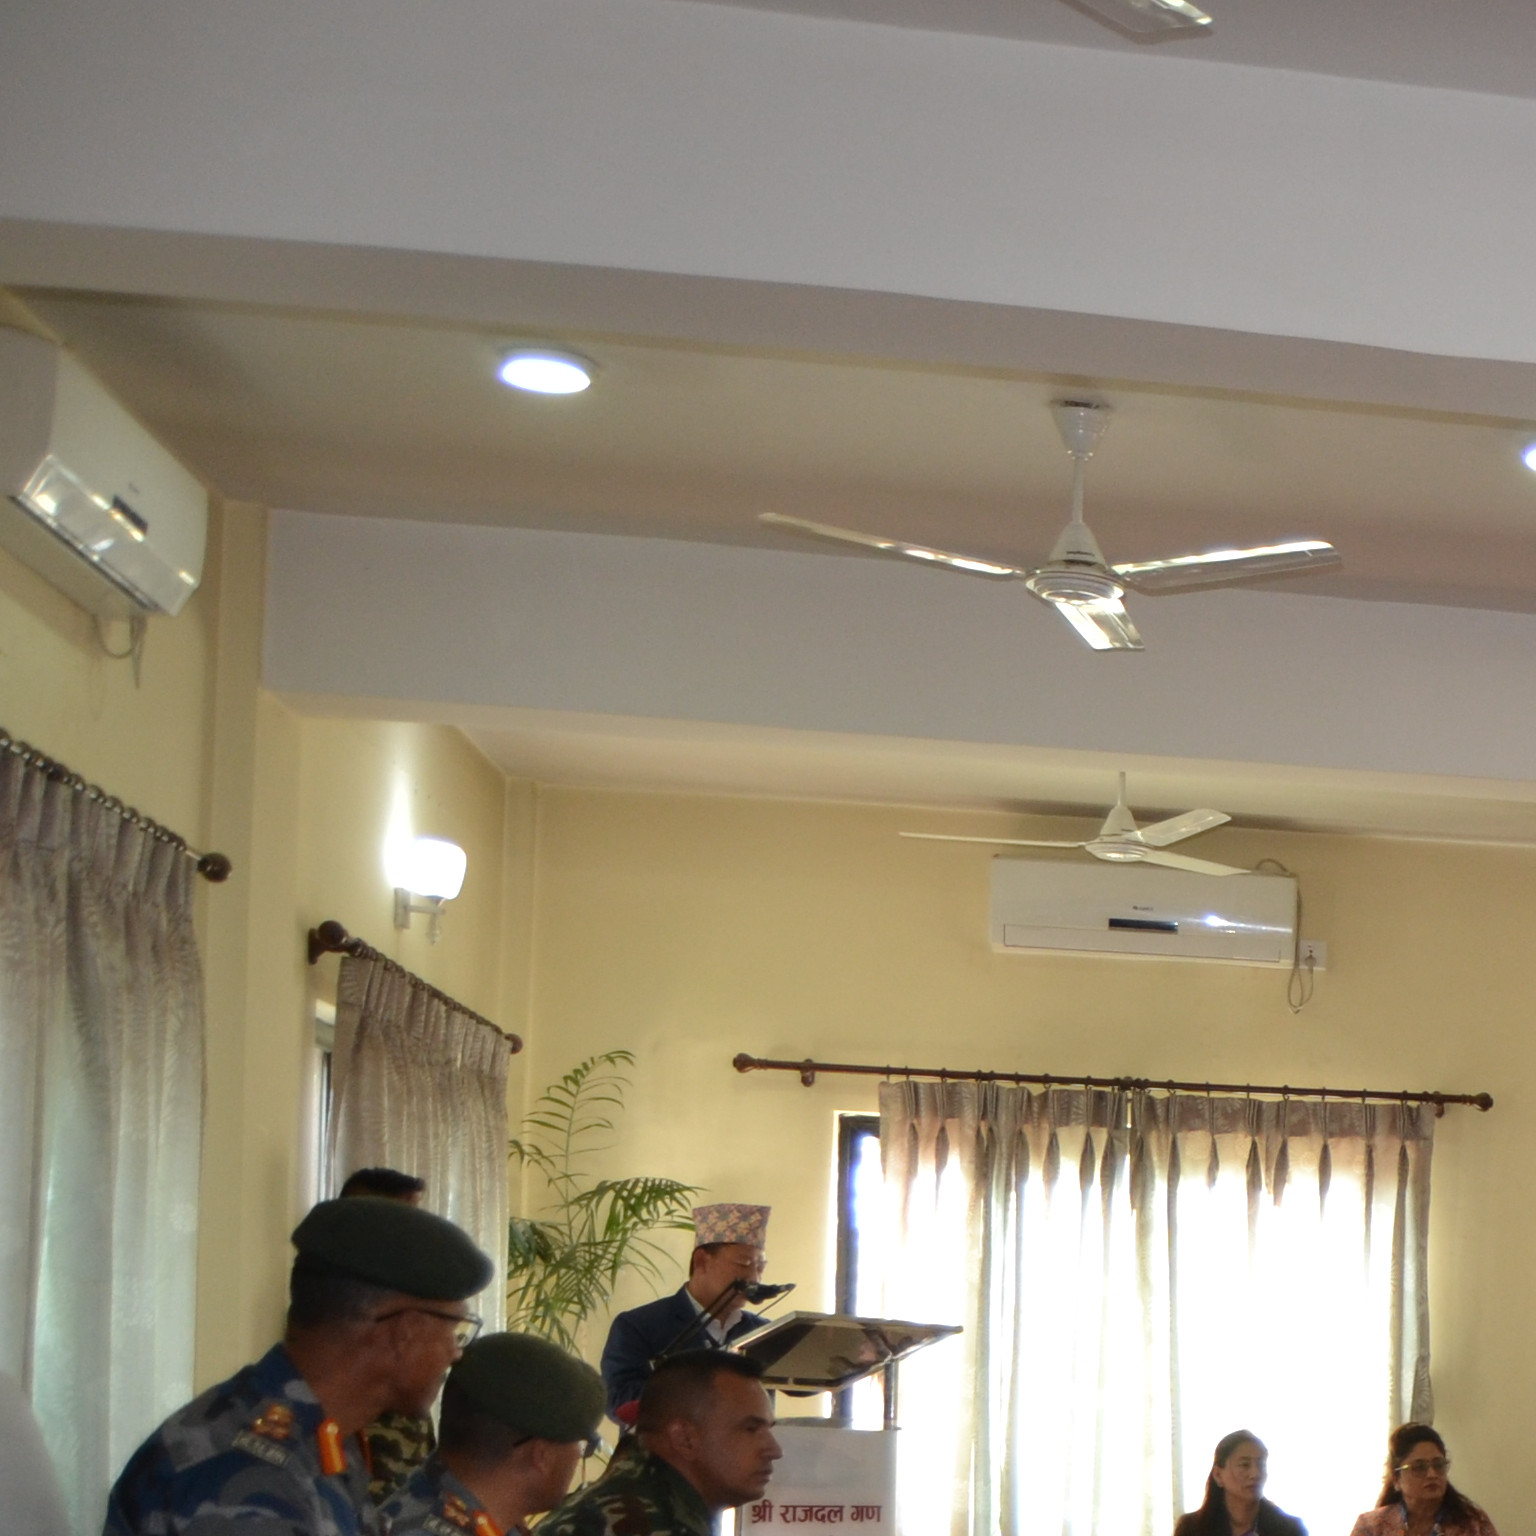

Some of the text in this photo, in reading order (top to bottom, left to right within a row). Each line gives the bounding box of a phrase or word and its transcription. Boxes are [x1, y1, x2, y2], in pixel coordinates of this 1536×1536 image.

[751, 1499, 882, 1524] श्री राजदल गण
